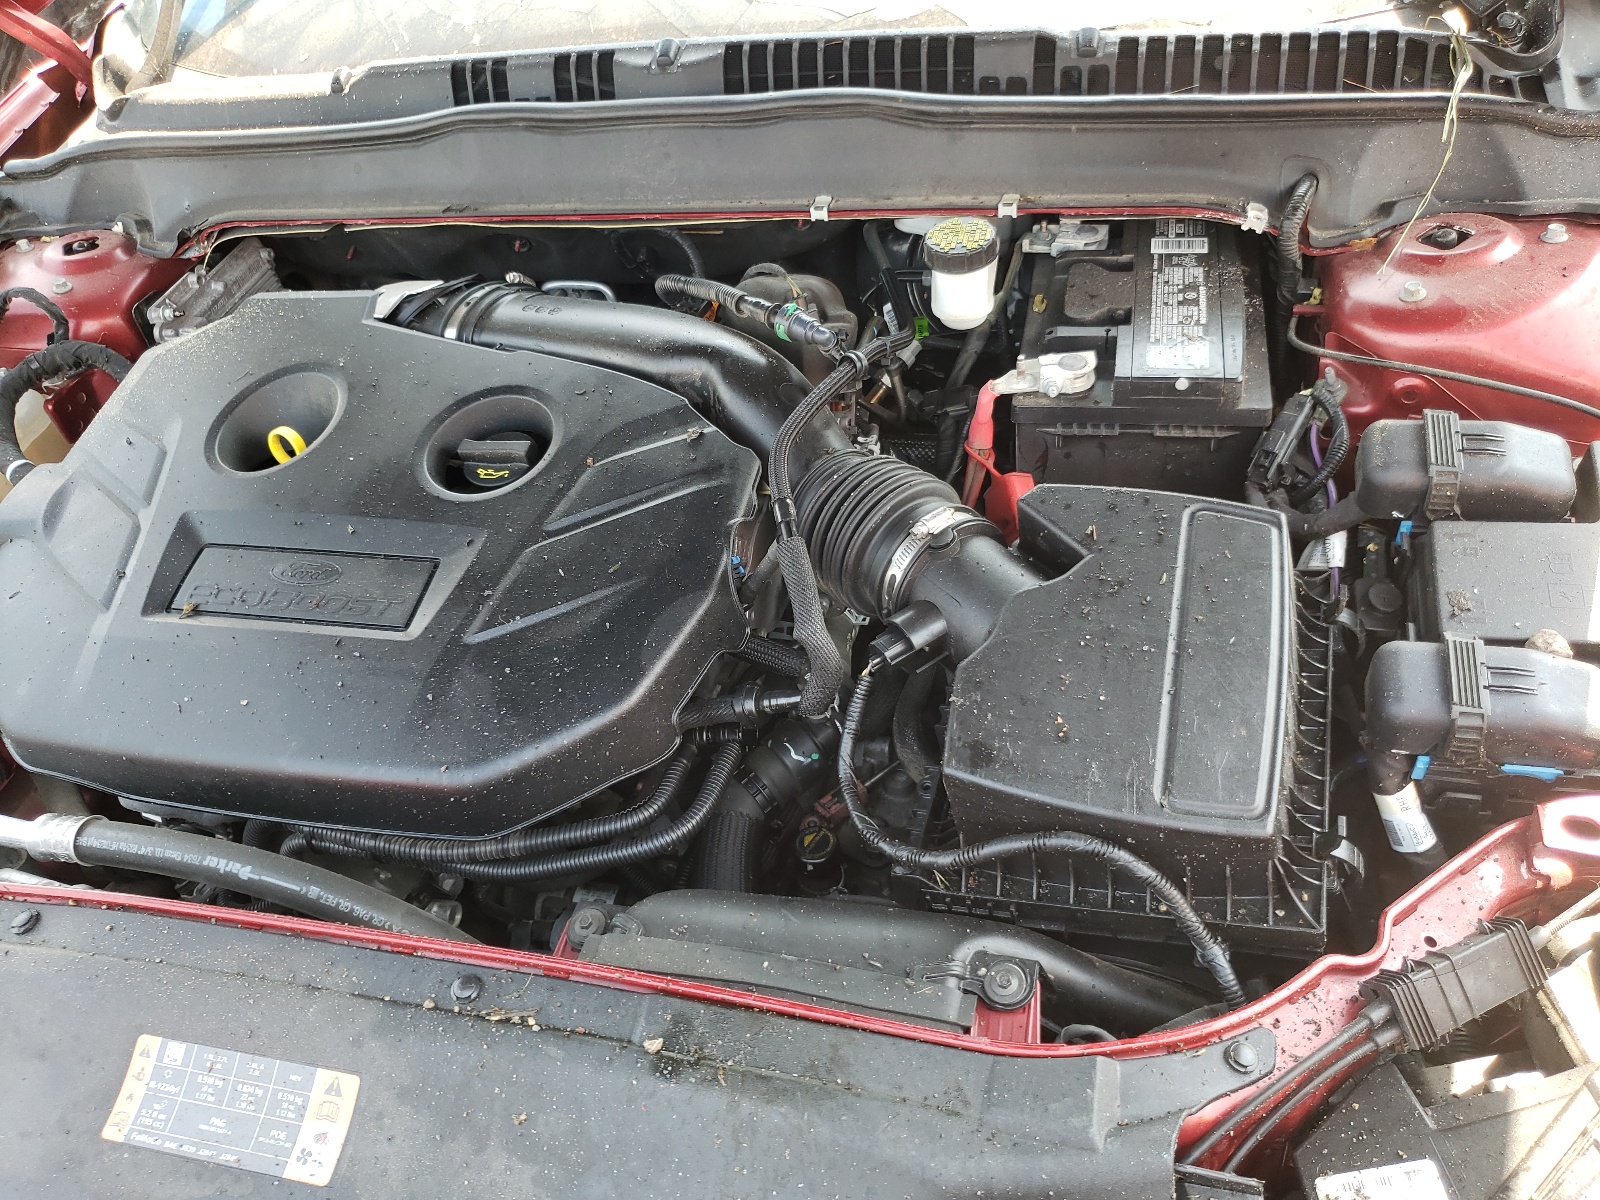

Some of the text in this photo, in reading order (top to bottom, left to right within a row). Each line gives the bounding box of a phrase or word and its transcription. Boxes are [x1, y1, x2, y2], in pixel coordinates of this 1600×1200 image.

[280, 561, 330, 582] Ford
[202, 856, 252, 881] Parker
[209, 1117, 227, 1127] PAG
[269, 1130, 288, 1140] POE
